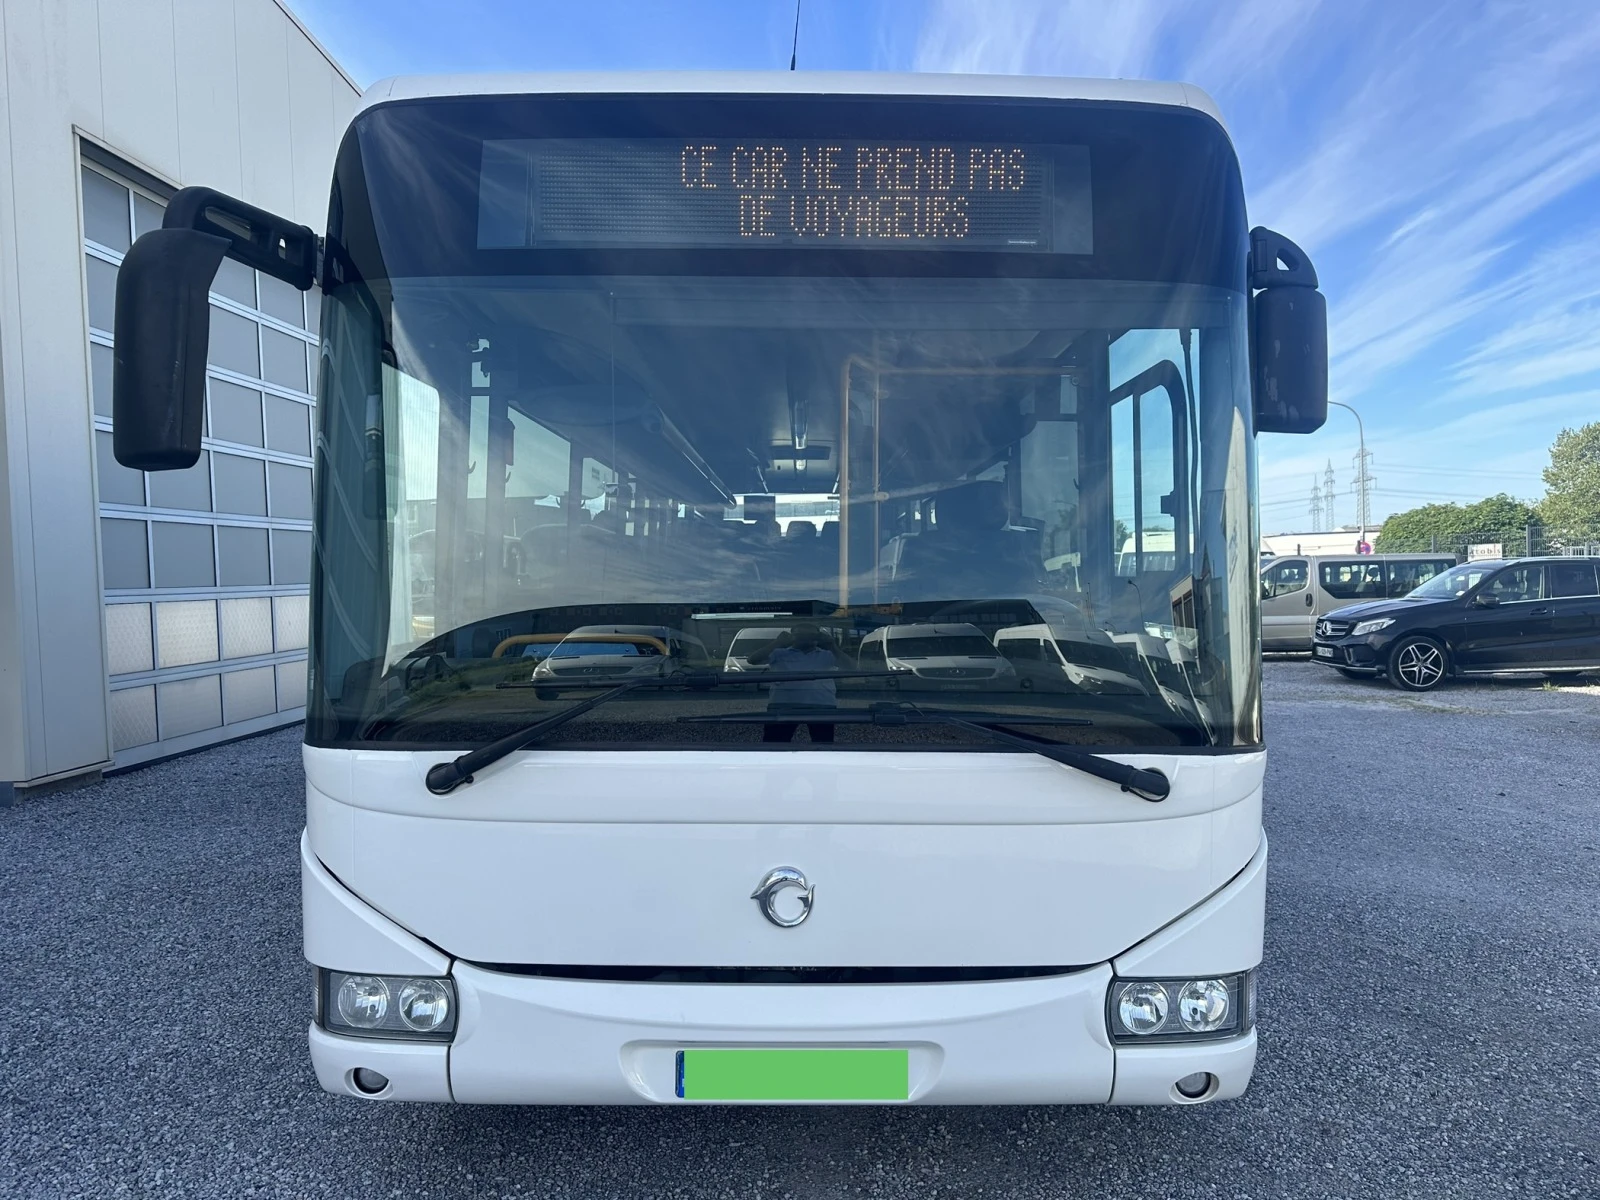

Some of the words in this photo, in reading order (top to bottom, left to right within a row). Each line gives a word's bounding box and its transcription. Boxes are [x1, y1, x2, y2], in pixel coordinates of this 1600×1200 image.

[682, 146, 717, 188] CE
[732, 146, 787, 189] CAR
[802, 147, 842, 189] NE
[856, 147, 955, 190] PREND
[969, 148, 1025, 190] PAS
[740, 195, 775, 236] DE
[790, 195, 969, 238] VOYAGEURS
